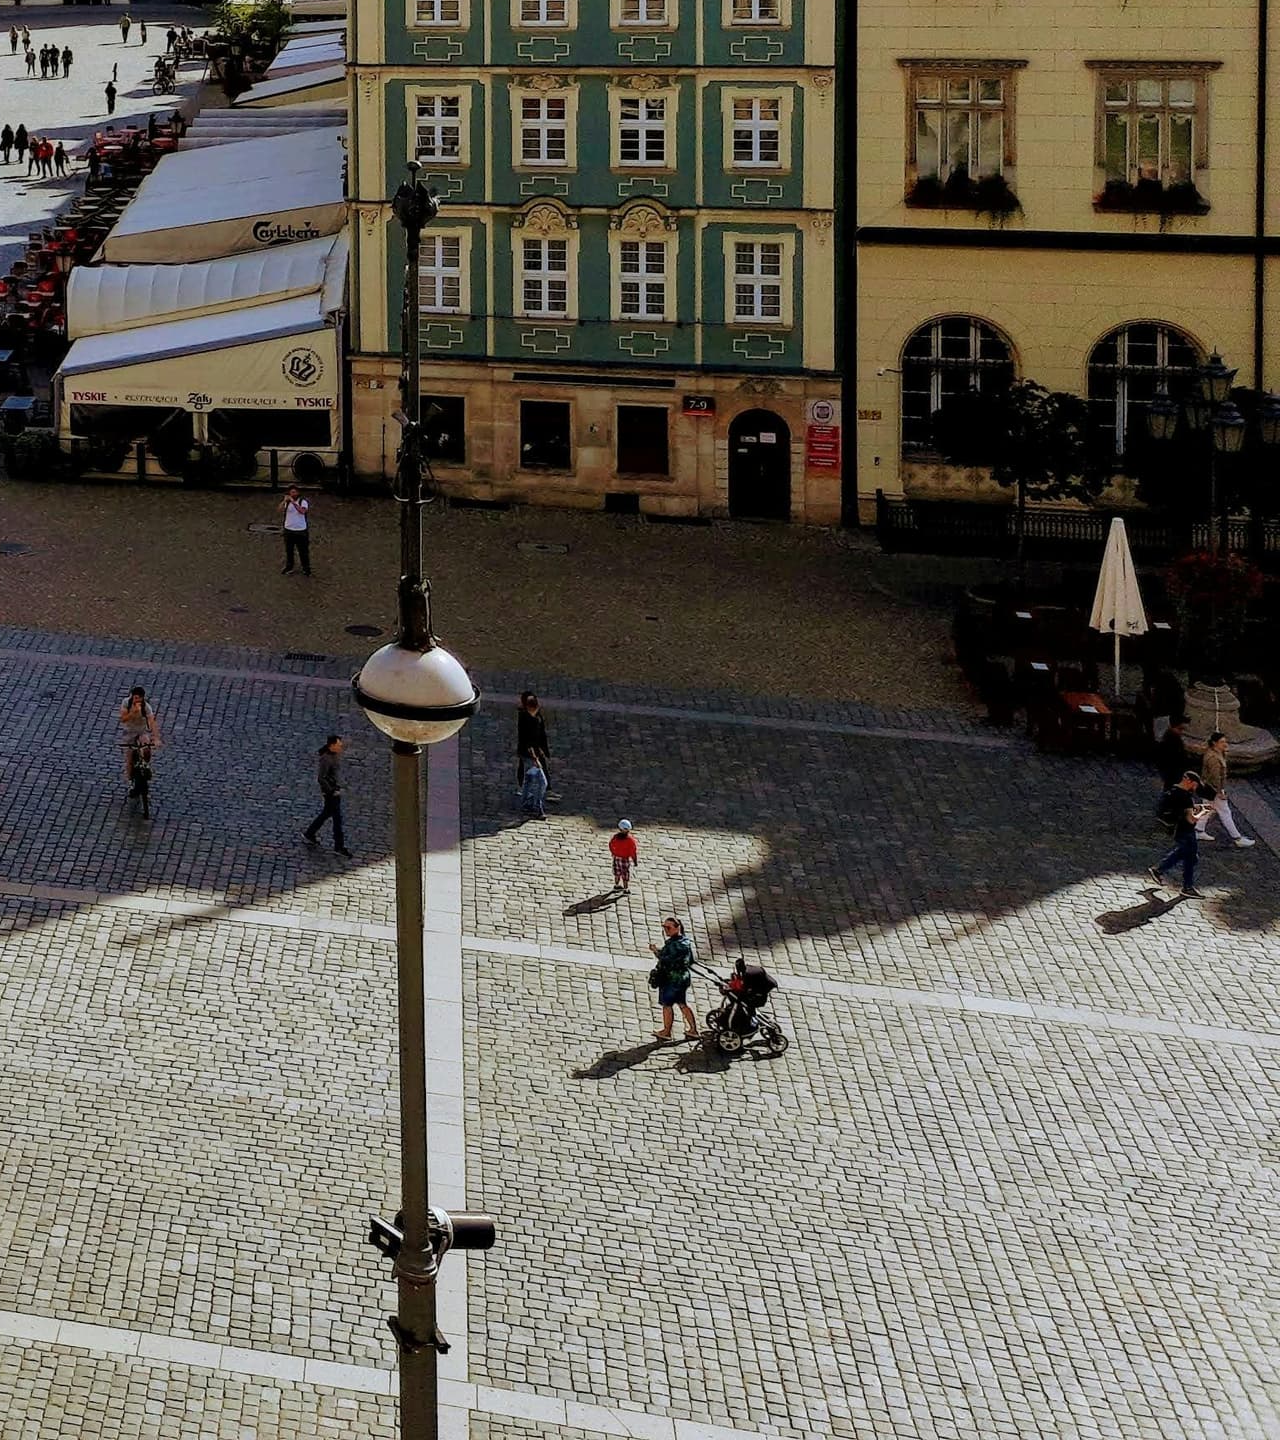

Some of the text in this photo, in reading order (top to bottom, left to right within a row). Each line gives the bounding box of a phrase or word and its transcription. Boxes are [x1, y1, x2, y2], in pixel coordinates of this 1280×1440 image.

[72, 391, 107, 402] TYSKIE
[294, 397, 333, 408] TYSKIE
[689, 400, 707, 410] 7-9
